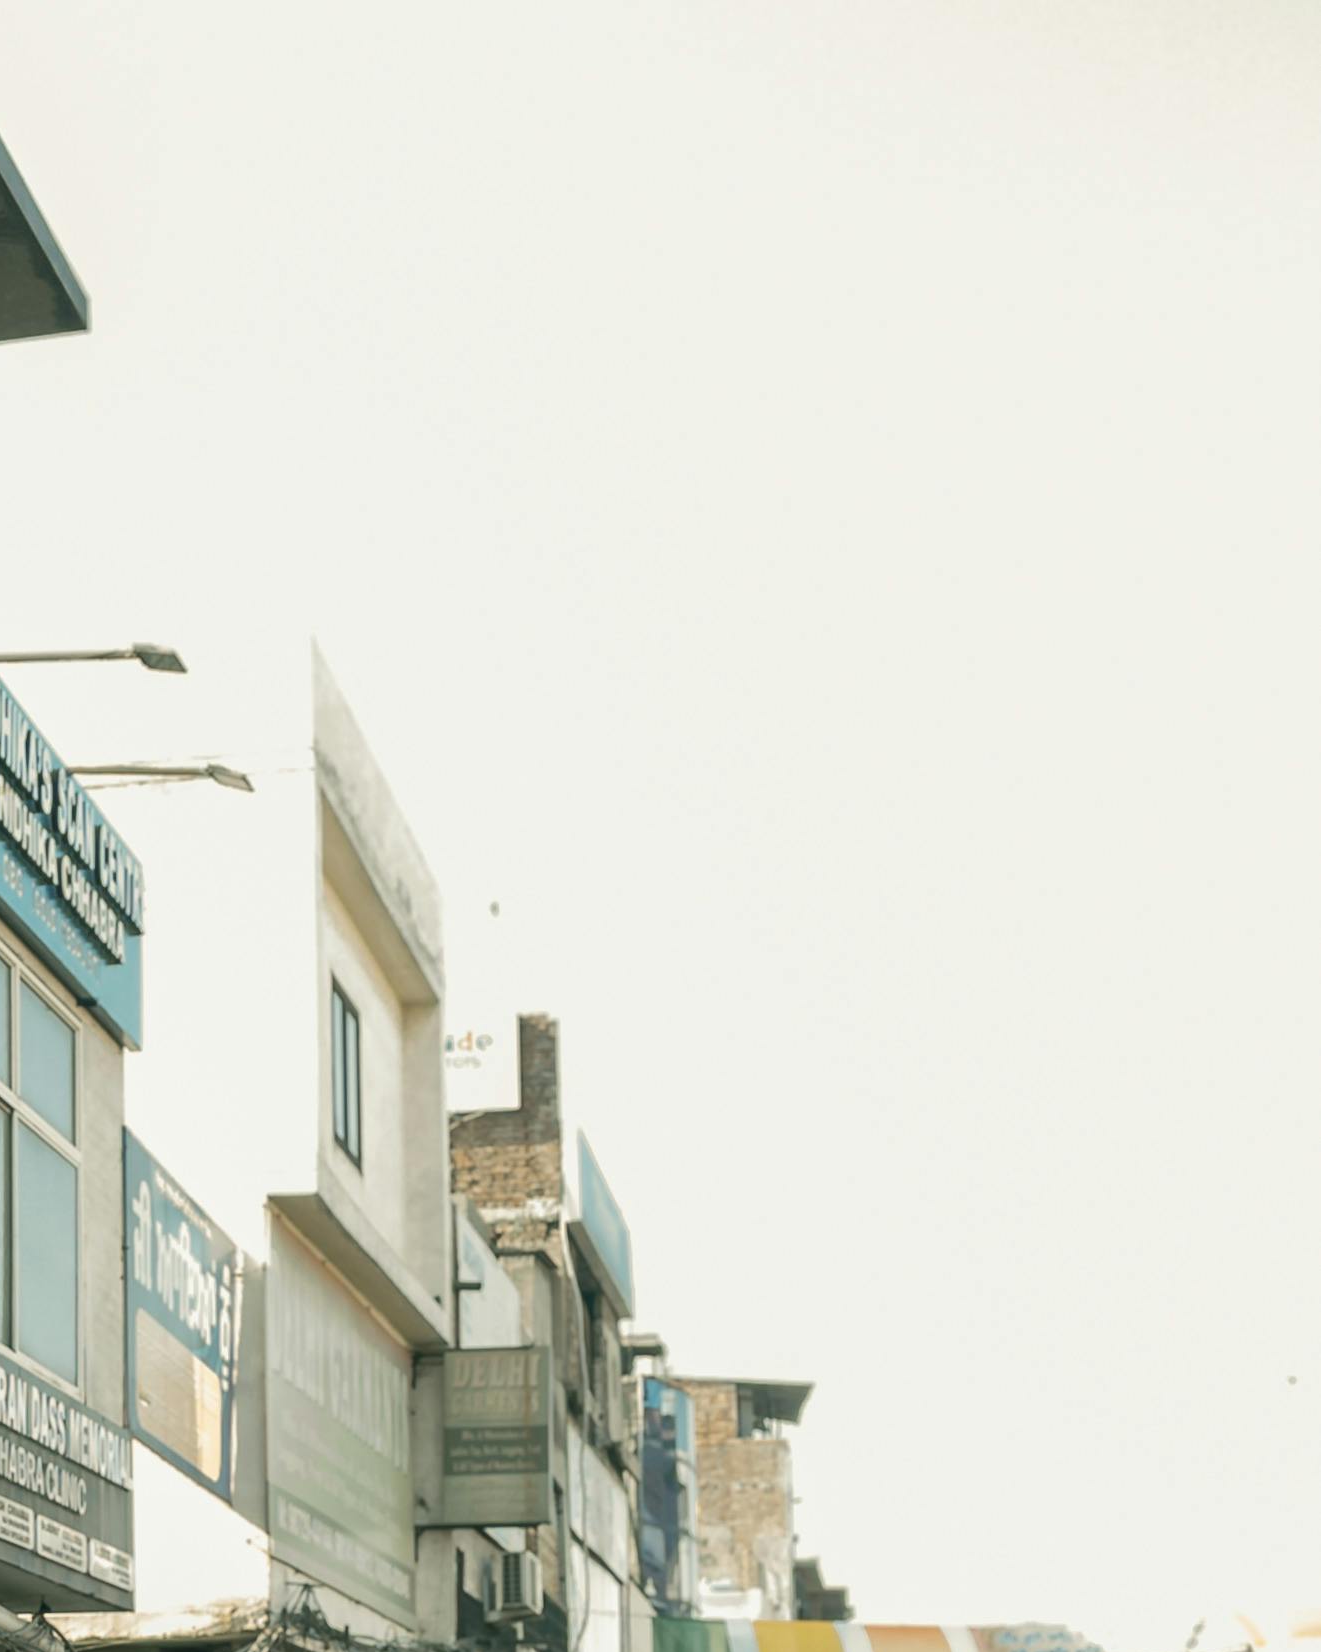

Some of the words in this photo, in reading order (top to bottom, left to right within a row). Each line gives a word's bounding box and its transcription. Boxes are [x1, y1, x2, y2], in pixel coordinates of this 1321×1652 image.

[57, 767, 96, 871] SCAN
[60, 855, 124, 964] CHHABRA
[31, 1385, 67, 1455] DASS
[69, 1407, 133, 1491] MEMORIAL
[46, 1461, 88, 1516] CLINIC
